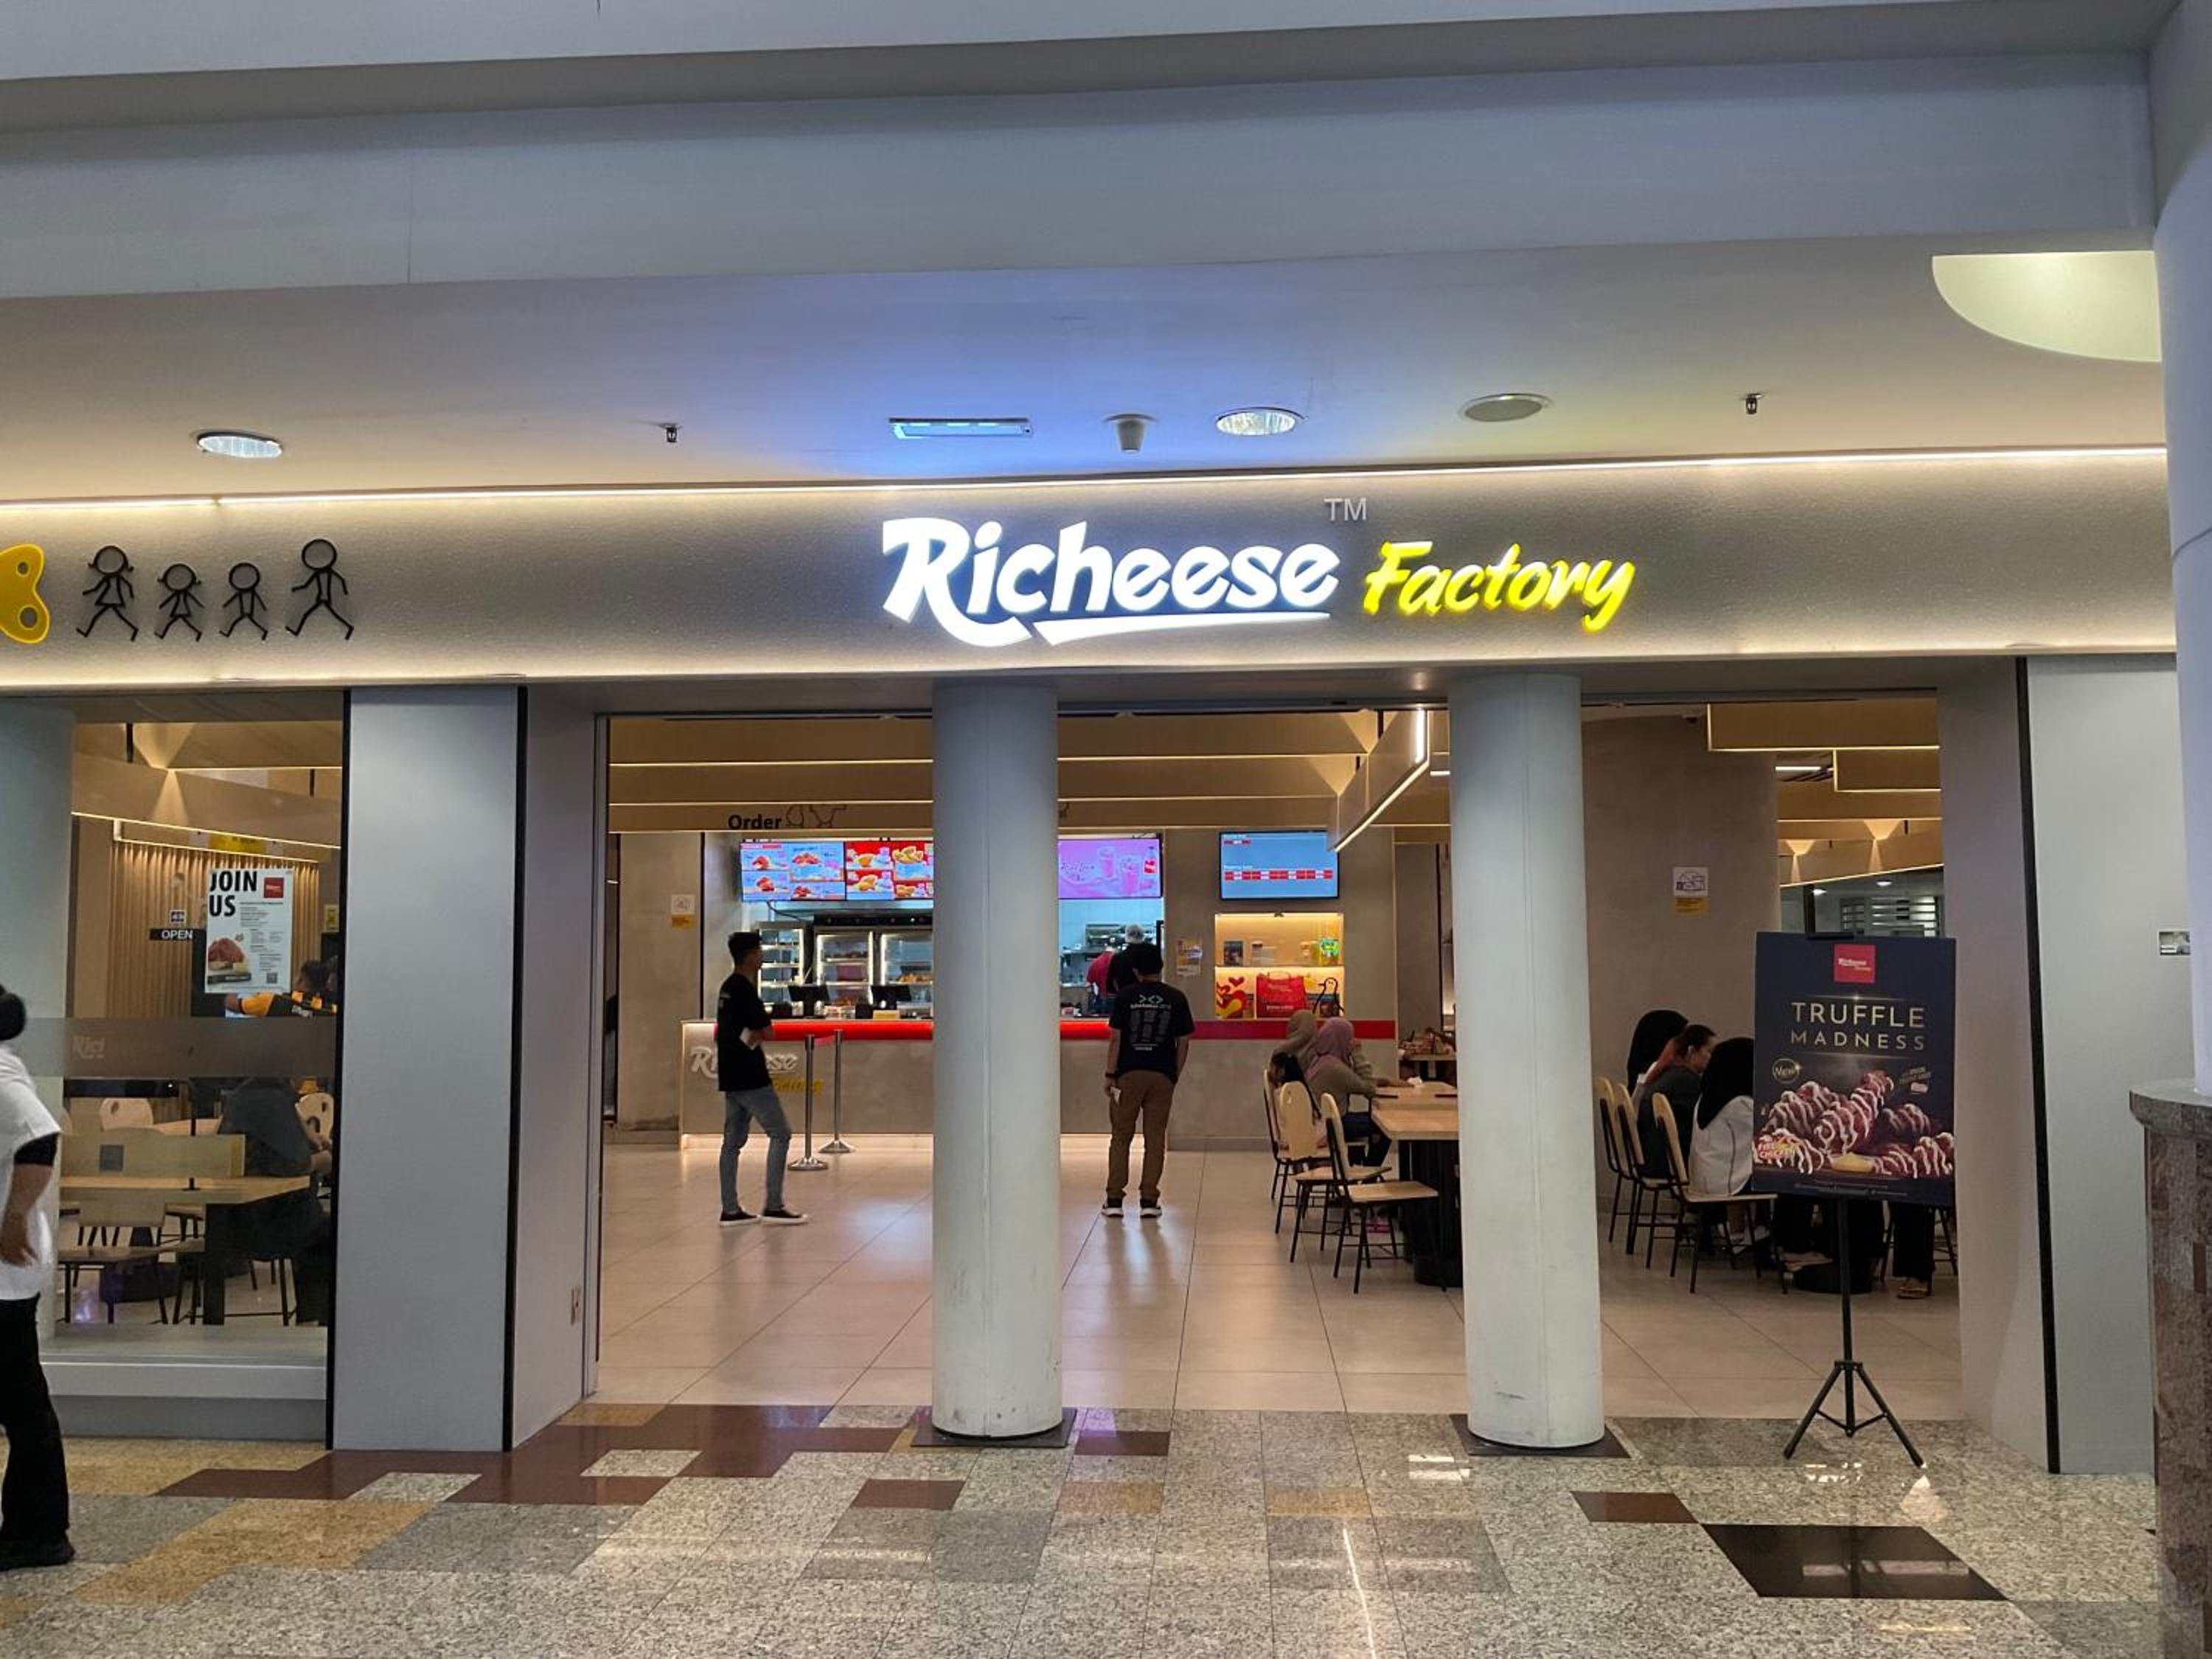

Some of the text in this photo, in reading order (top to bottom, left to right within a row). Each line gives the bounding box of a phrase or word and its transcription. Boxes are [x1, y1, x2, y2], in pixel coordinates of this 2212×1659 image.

[1324, 497, 1368, 522] TM
[882, 516, 1635, 647] Richeese Factory
[728, 814, 782, 830] Order
[209, 870, 257, 892] JOIN
[209, 894, 236, 917] US
[161, 929, 193, 940] OPEN
[1791, 1002, 1925, 1029] TRUFFLE
[1791, 1030, 1924, 1051] MADNESS
